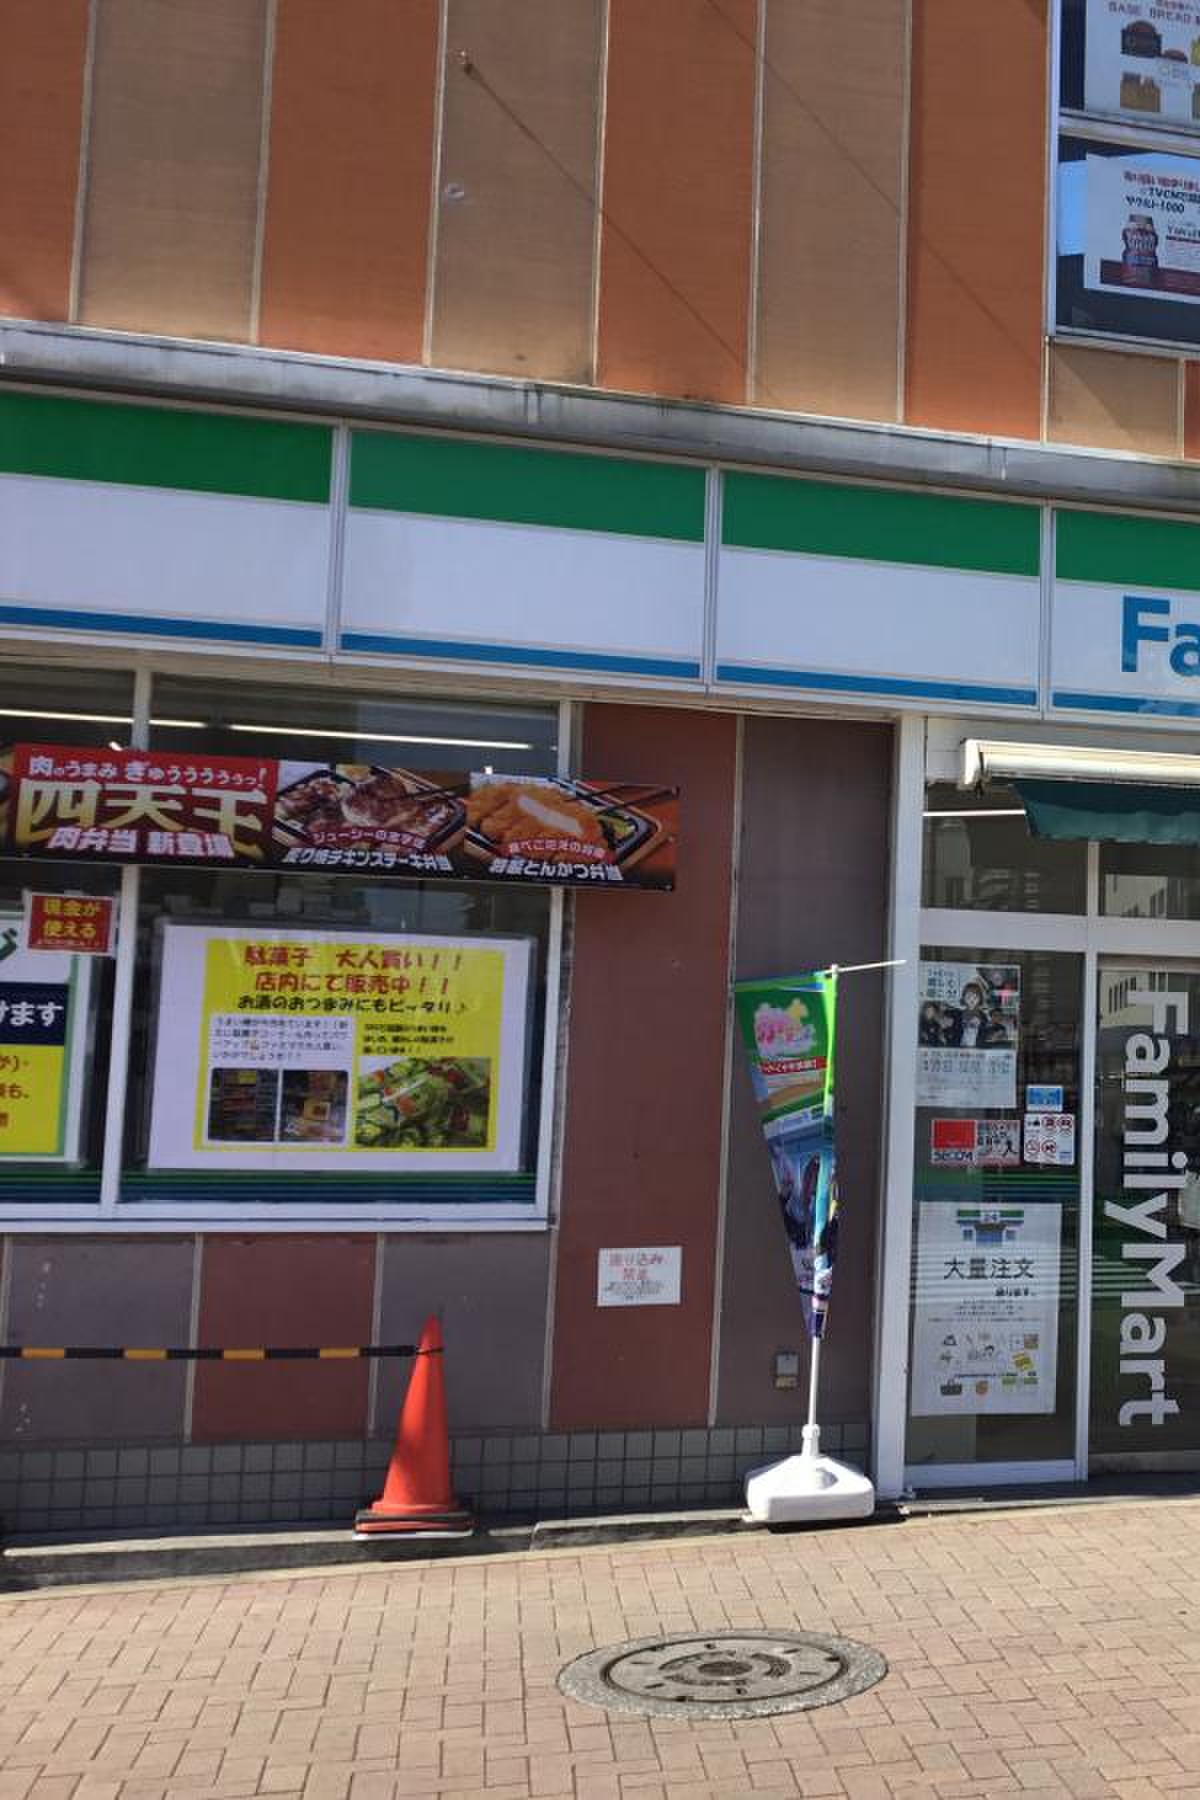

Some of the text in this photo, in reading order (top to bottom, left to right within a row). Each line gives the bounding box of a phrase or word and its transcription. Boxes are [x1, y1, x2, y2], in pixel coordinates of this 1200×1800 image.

[15, 776, 270, 860] 四天王
[47, 826, 138, 854] 肉弁当
[43, 922, 97, 939] 使える
[1104, 991, 1189, 1426] FamilyMart
[943, 1256, 1035, 1280] 大量注文
